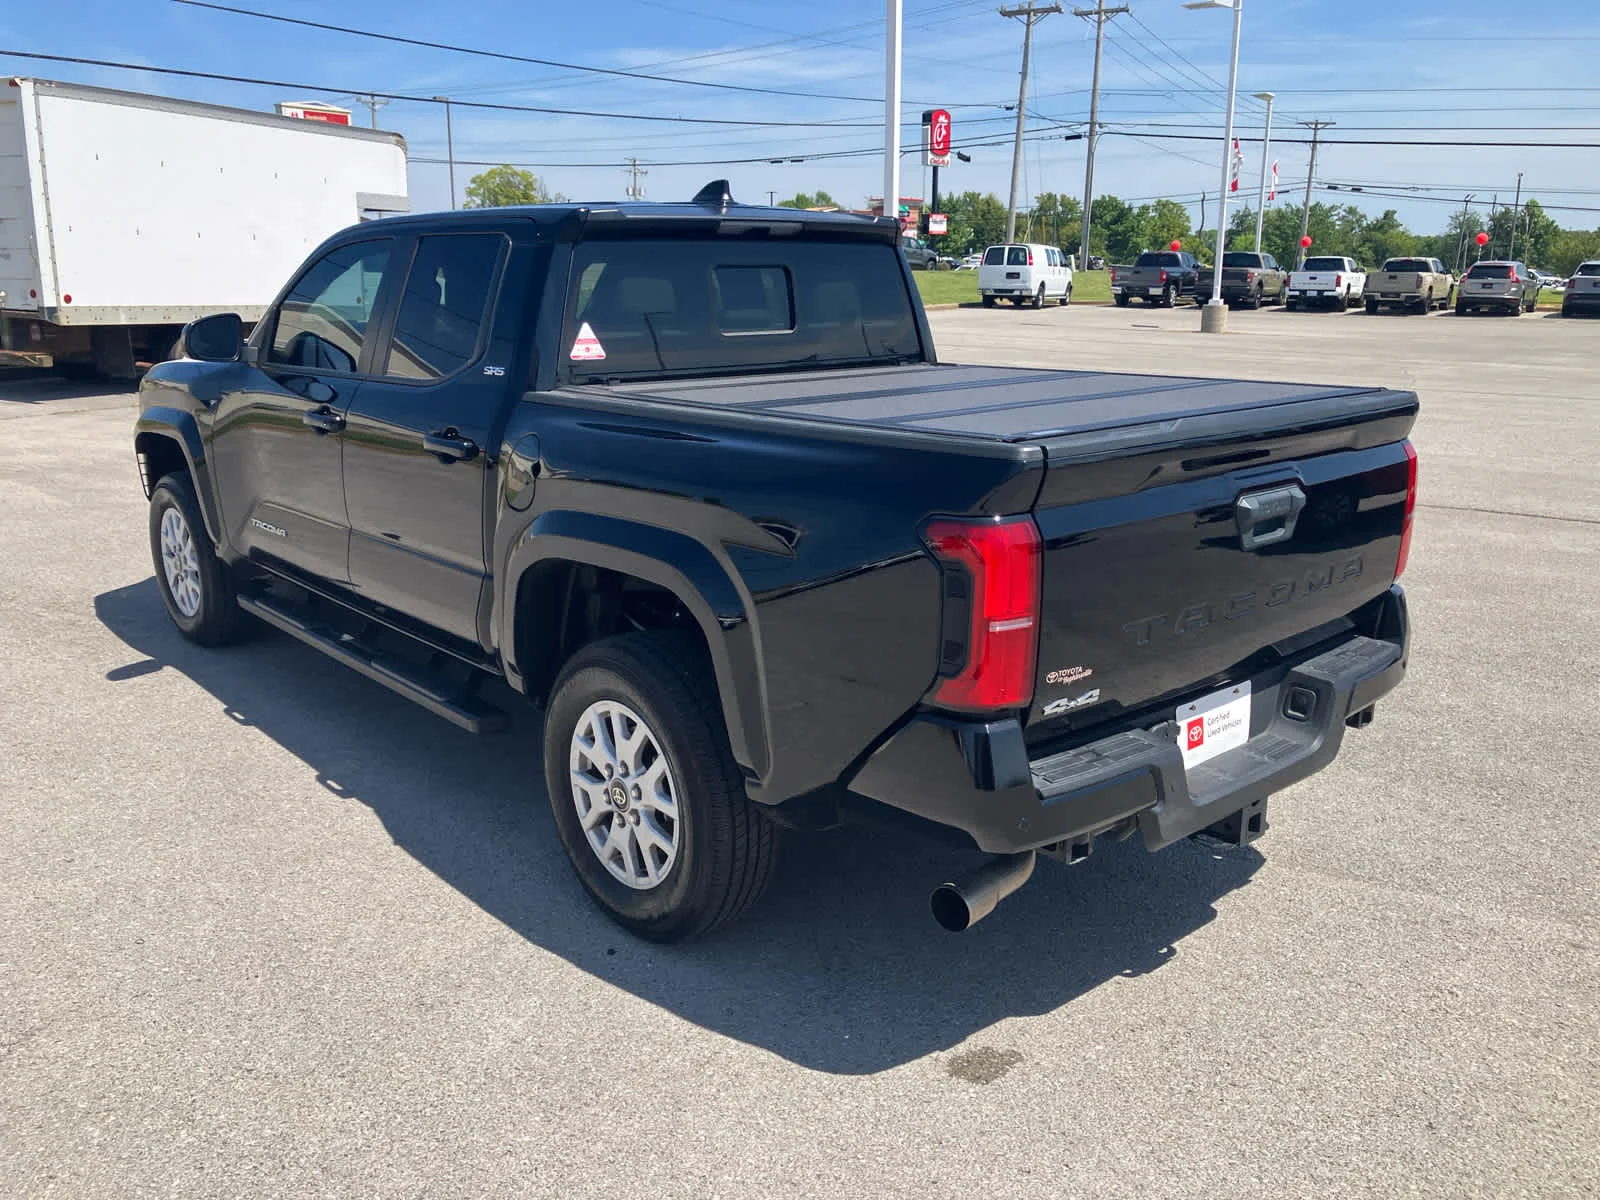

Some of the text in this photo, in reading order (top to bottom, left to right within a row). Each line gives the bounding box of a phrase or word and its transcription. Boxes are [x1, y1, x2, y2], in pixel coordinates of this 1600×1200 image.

[251, 518, 286, 536] TACOMA
[1121, 556, 1364, 646] TACOMA
[1058, 666, 1083, 677] TOYOTA
[1207, 711, 1231, 726] Certified
[1207, 718, 1242, 738] Used Vehicles
